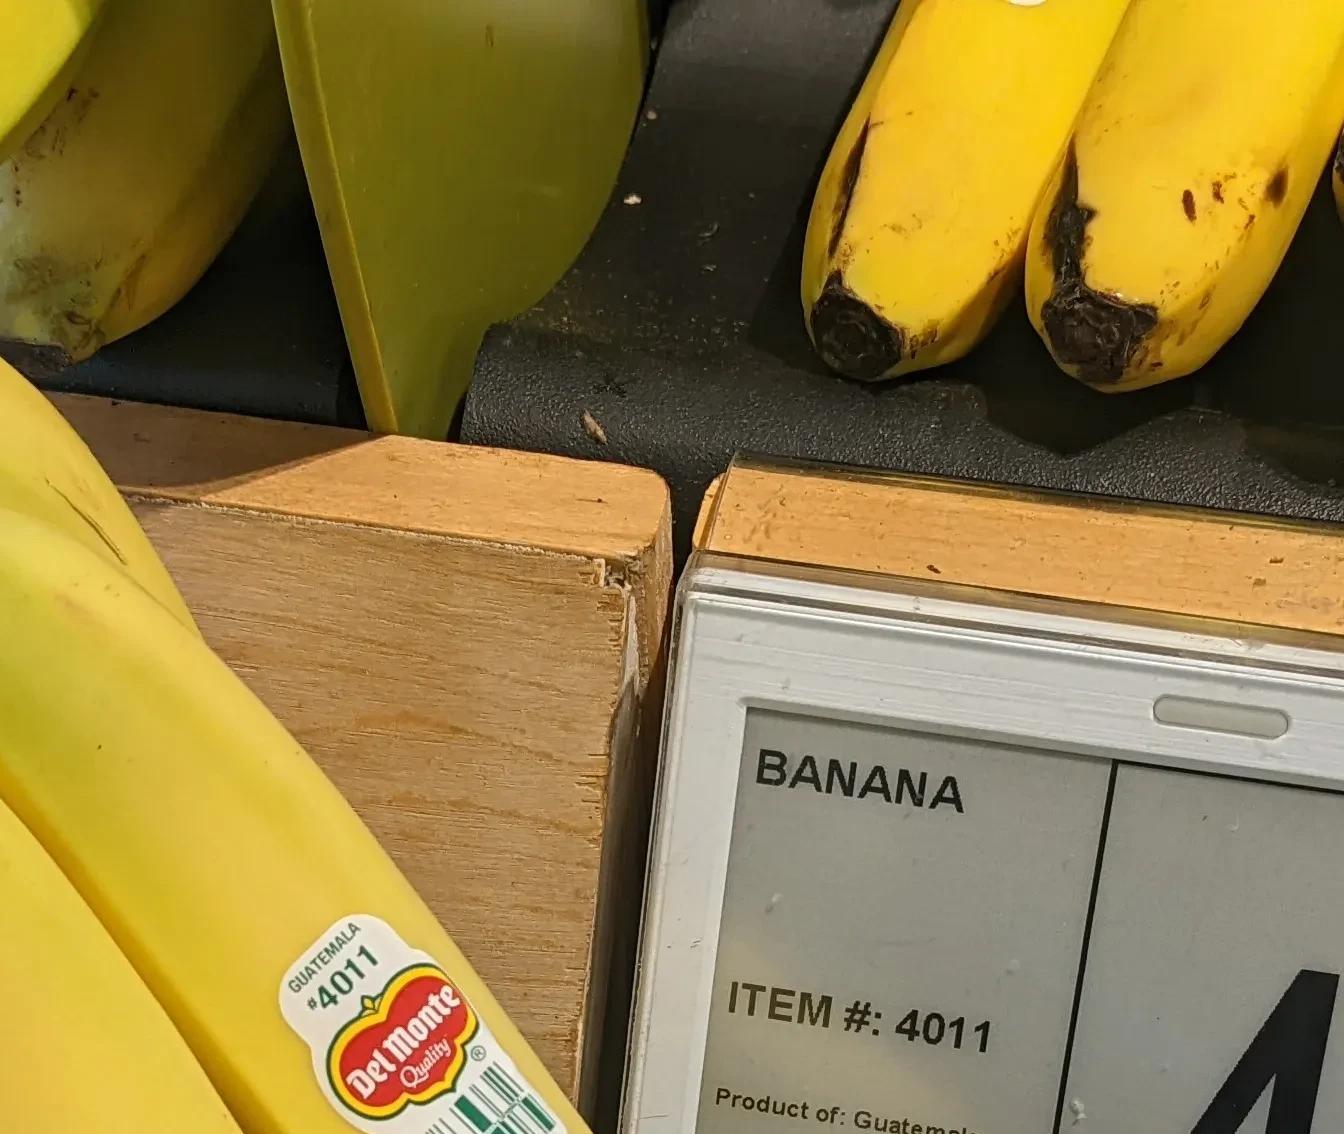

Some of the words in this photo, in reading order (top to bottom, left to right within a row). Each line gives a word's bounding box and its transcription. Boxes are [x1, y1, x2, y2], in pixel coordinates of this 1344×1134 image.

[756, 748, 965, 814] BANANA
[287, 922, 361, 994] GUATEMALA
[346, 1049, 395, 1099] Del
[383, 984, 460, 1062] Monte
[727, 980, 832, 1029] ITEM
[844, 1000, 882, 1036] #:
[895, 1009, 992, 1054] 4011
[399, 1038, 452, 1089] Quality
[715, 1087, 809, 1120] Product
[816, 1104, 845, 1126] of:
